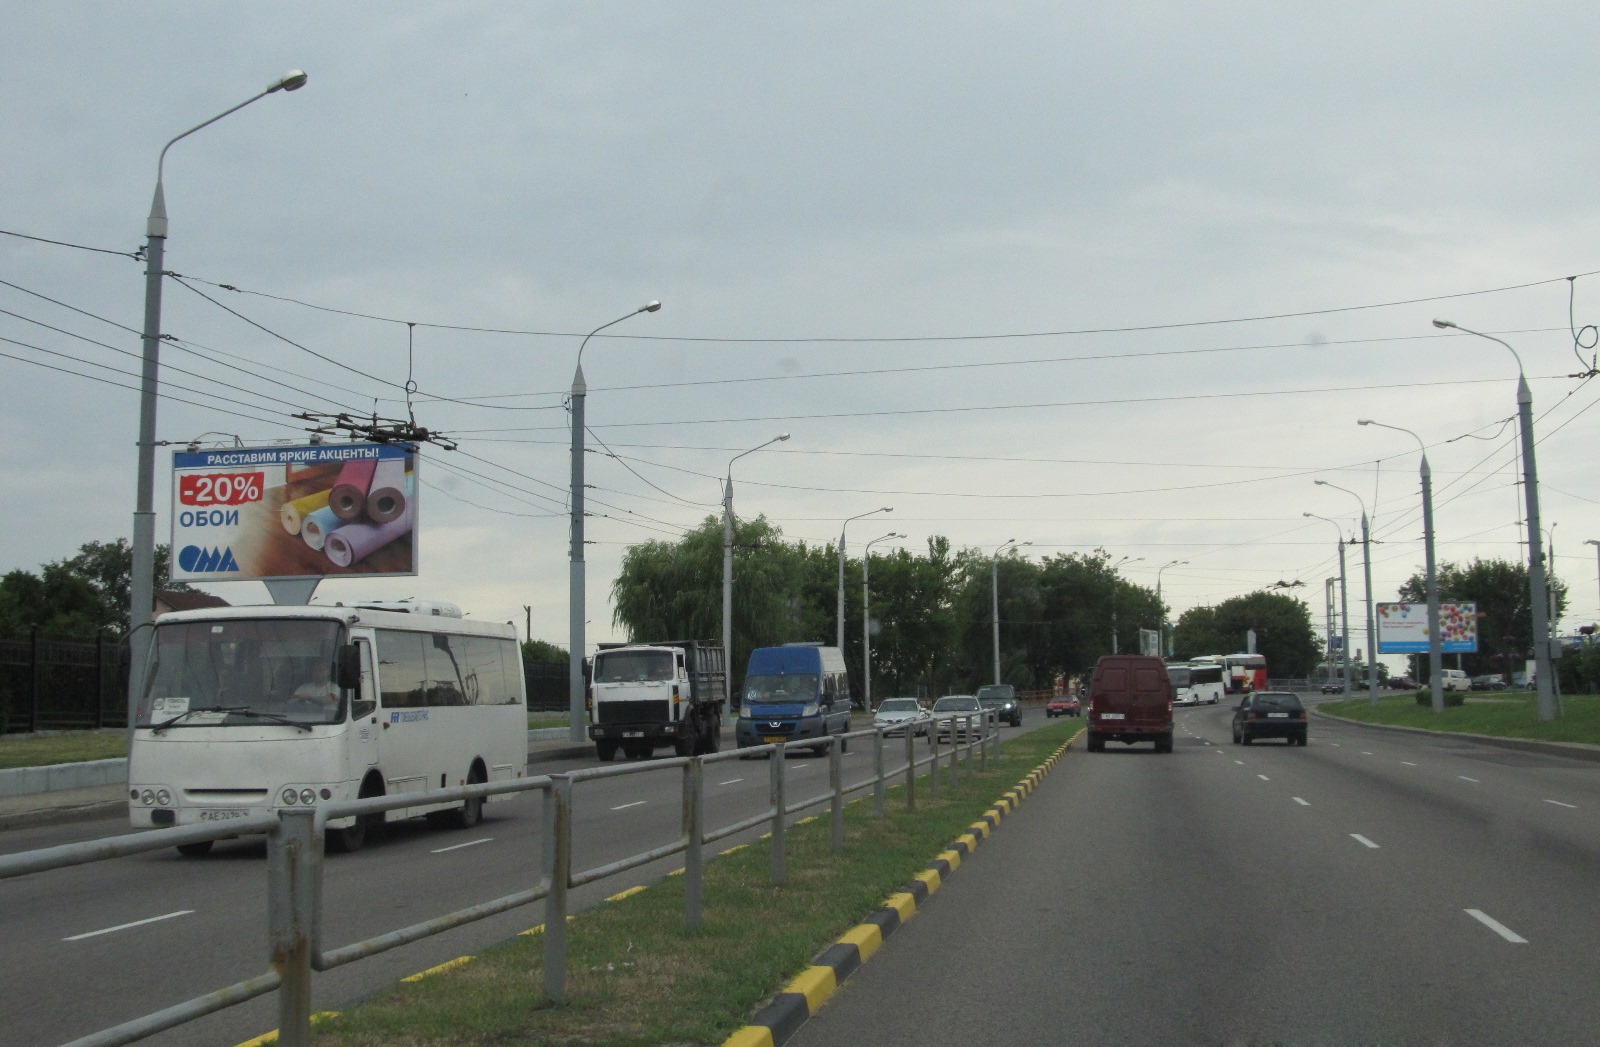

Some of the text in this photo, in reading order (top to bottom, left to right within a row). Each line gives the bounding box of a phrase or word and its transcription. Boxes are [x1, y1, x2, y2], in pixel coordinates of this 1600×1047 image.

[207, 448, 379, 464] РАССТАВИМ ЯРКИЕ АКЦЕНТЫ!
[183, 476, 259, 502] -20%
[180, 509, 239, 528] ОБОИ
[178, 544, 240, 573] ОМА
